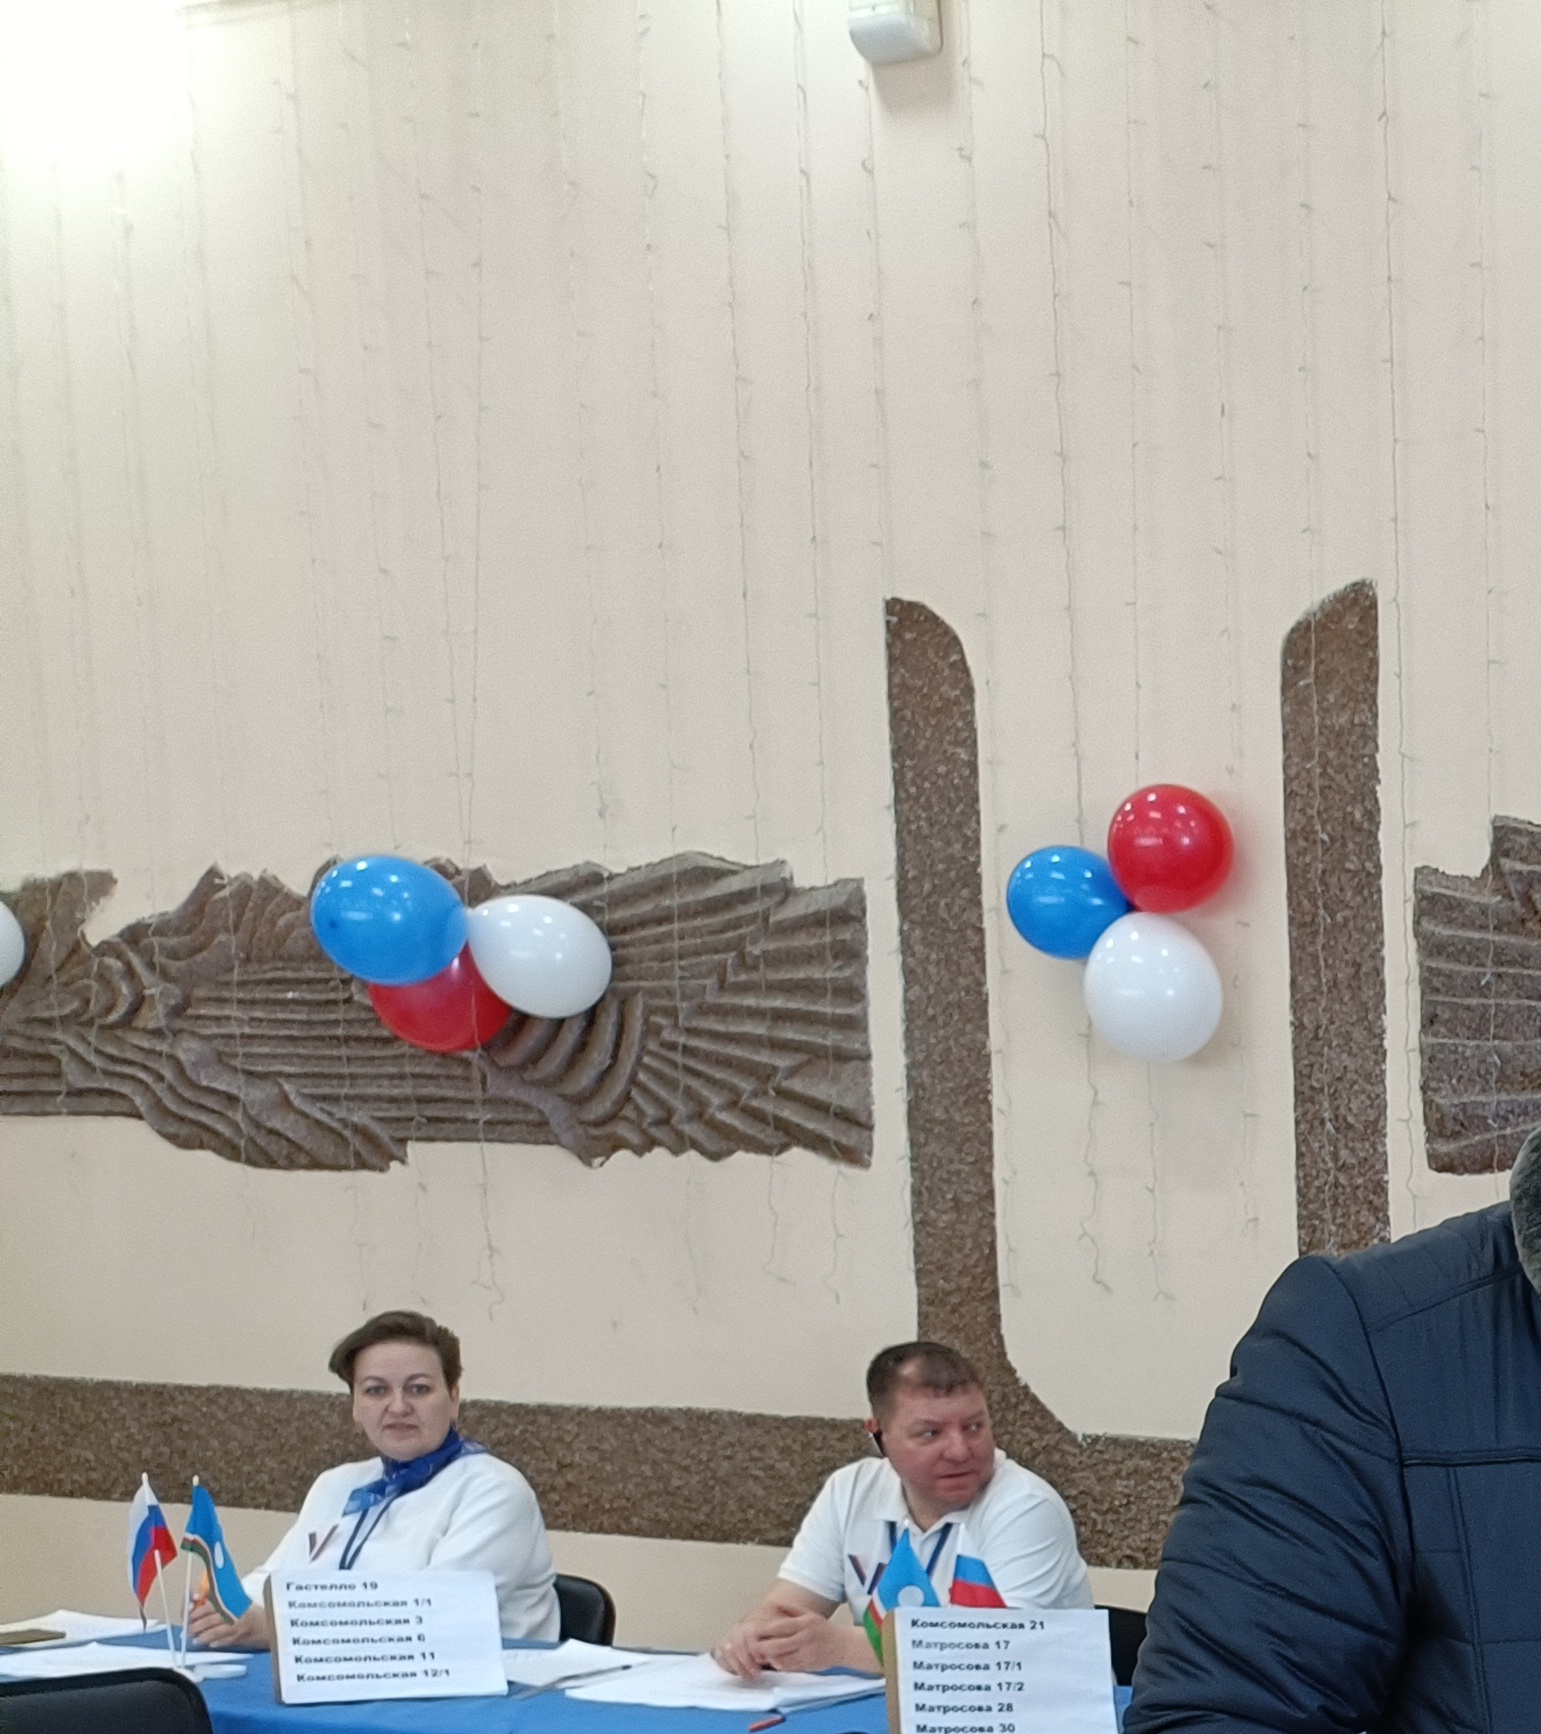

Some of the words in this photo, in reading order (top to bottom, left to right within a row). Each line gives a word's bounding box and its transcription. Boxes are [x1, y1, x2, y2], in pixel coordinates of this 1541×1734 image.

[286, 1582, 356, 1591] Гастелло
[288, 1601, 408, 1609] Комсомольская
[414, 1598, 432, 1607] 1/1
[290, 1619, 410, 1627] Комсомольская
[911, 1619, 1025, 1629] Комсомольская
[1030, 1620, 1045, 1630] 21
[292, 1636, 412, 1645] Комсомольская
[911, 1640, 989, 1651] Матросова
[995, 1640, 1010, 1650] 17
[294, 1655, 414, 1664] Комсомольская
[420, 1652, 435, 1661] 11
[913, 1661, 990, 1672] Матросова
[996, 1661, 1022, 1671] 17/1
[297, 1672, 417, 1682] Комсомольская
[423, 1669, 450, 1678] 12/1
[914, 1682, 991, 1693] Матросова
[997, 1682, 1024, 1691] 17/2
[915, 1703, 992, 1715] Матросова
[998, 1703, 1013, 1712] 28
[916, 1724, 994, 1734] Матросова
[999, 1723, 1015, 1733] 30
